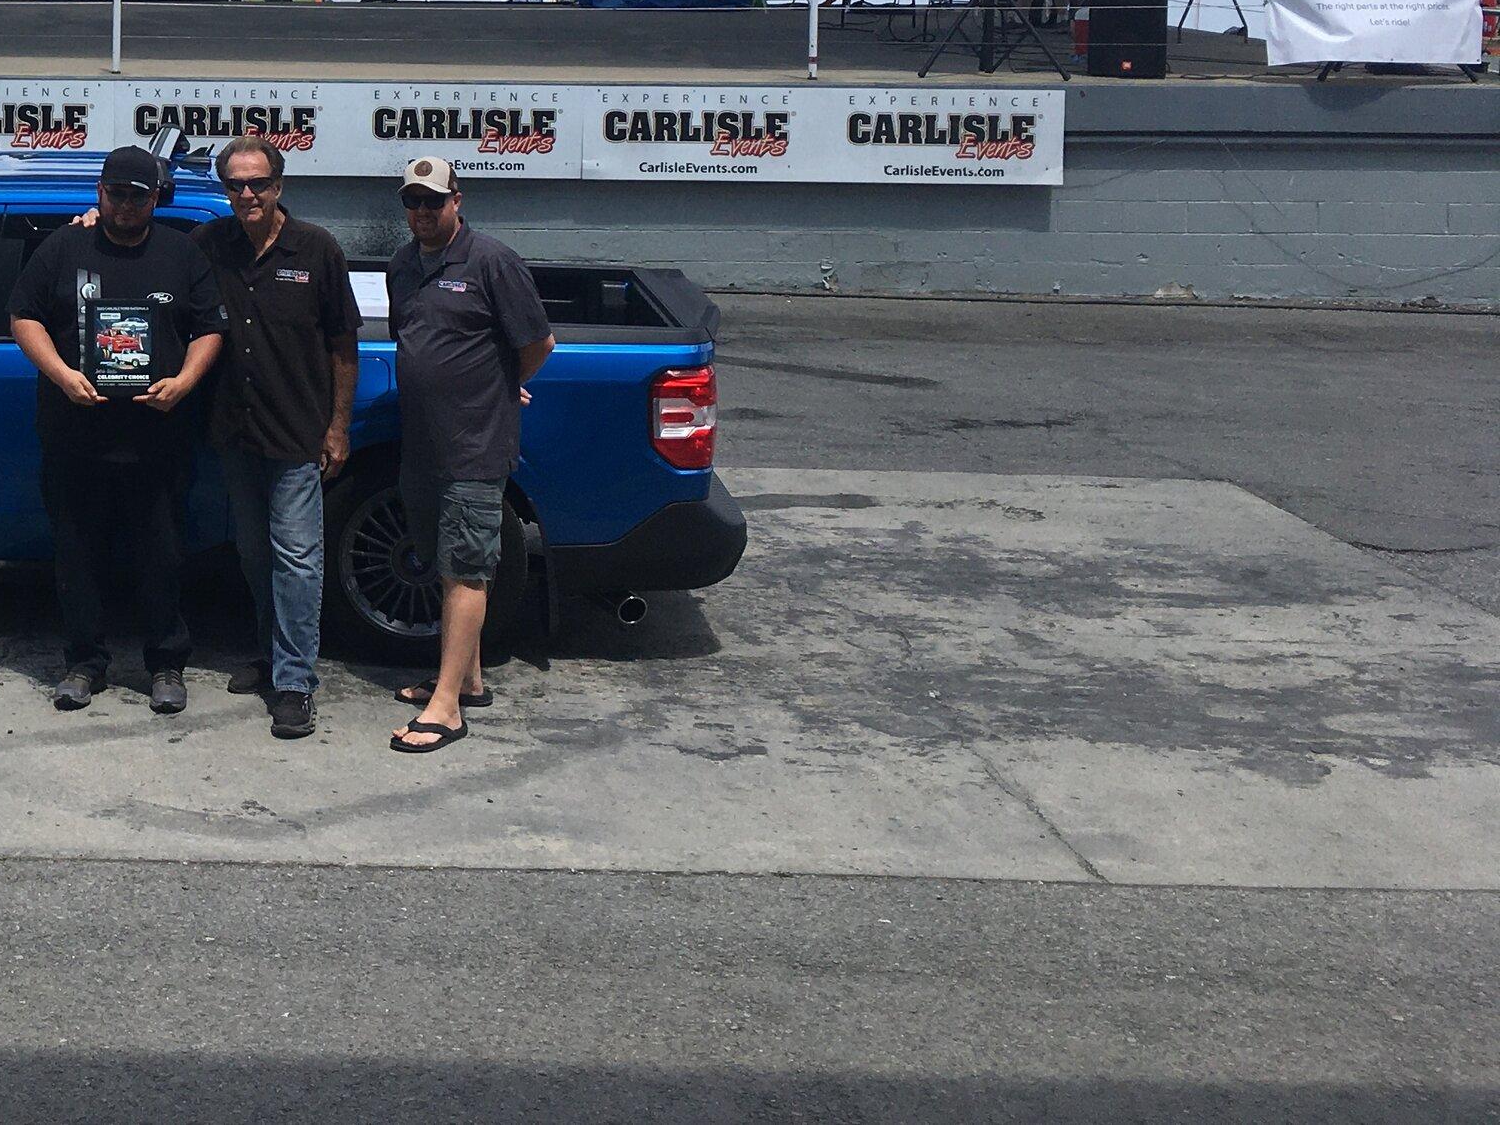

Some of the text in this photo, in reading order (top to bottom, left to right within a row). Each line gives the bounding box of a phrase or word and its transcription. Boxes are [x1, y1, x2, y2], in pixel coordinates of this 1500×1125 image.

[1316, 2, 1333, 11] The
[1335, 2, 1355, 12] right
[1356, 3, 1378, 12] parts
[1380, 3, 1389, 11] at
[1390, 2, 1405, 11] the
[1406, 2, 1426, 12] right
[1369, 18, 1390, 27] Let's
[135, 88, 318, 100] EXPERIENCE
[374, 90, 559, 103] EXPERIENCE
[602, 93, 789, 105] EXPERIENCE
[849, 95, 1039, 107] EXPERIENCE
[134, 103, 316, 138] CARLISLE
[372, 106, 557, 141] CARLISLE
[603, 110, 790, 144] CARLISLE
[847, 111, 1037, 146] CARLISLE
[10, 124, 87, 150] Events
[245, 127, 316, 151] ents
[478, 128, 556, 155] Events
[710, 132, 789, 158] Events
[956, 134, 1036, 160] Events
[408, 158, 525, 171] eEvents.com
[639, 161, 758, 174] CarlisleEvents.com
[884, 165, 1005, 177] CarlisleEvents.com
